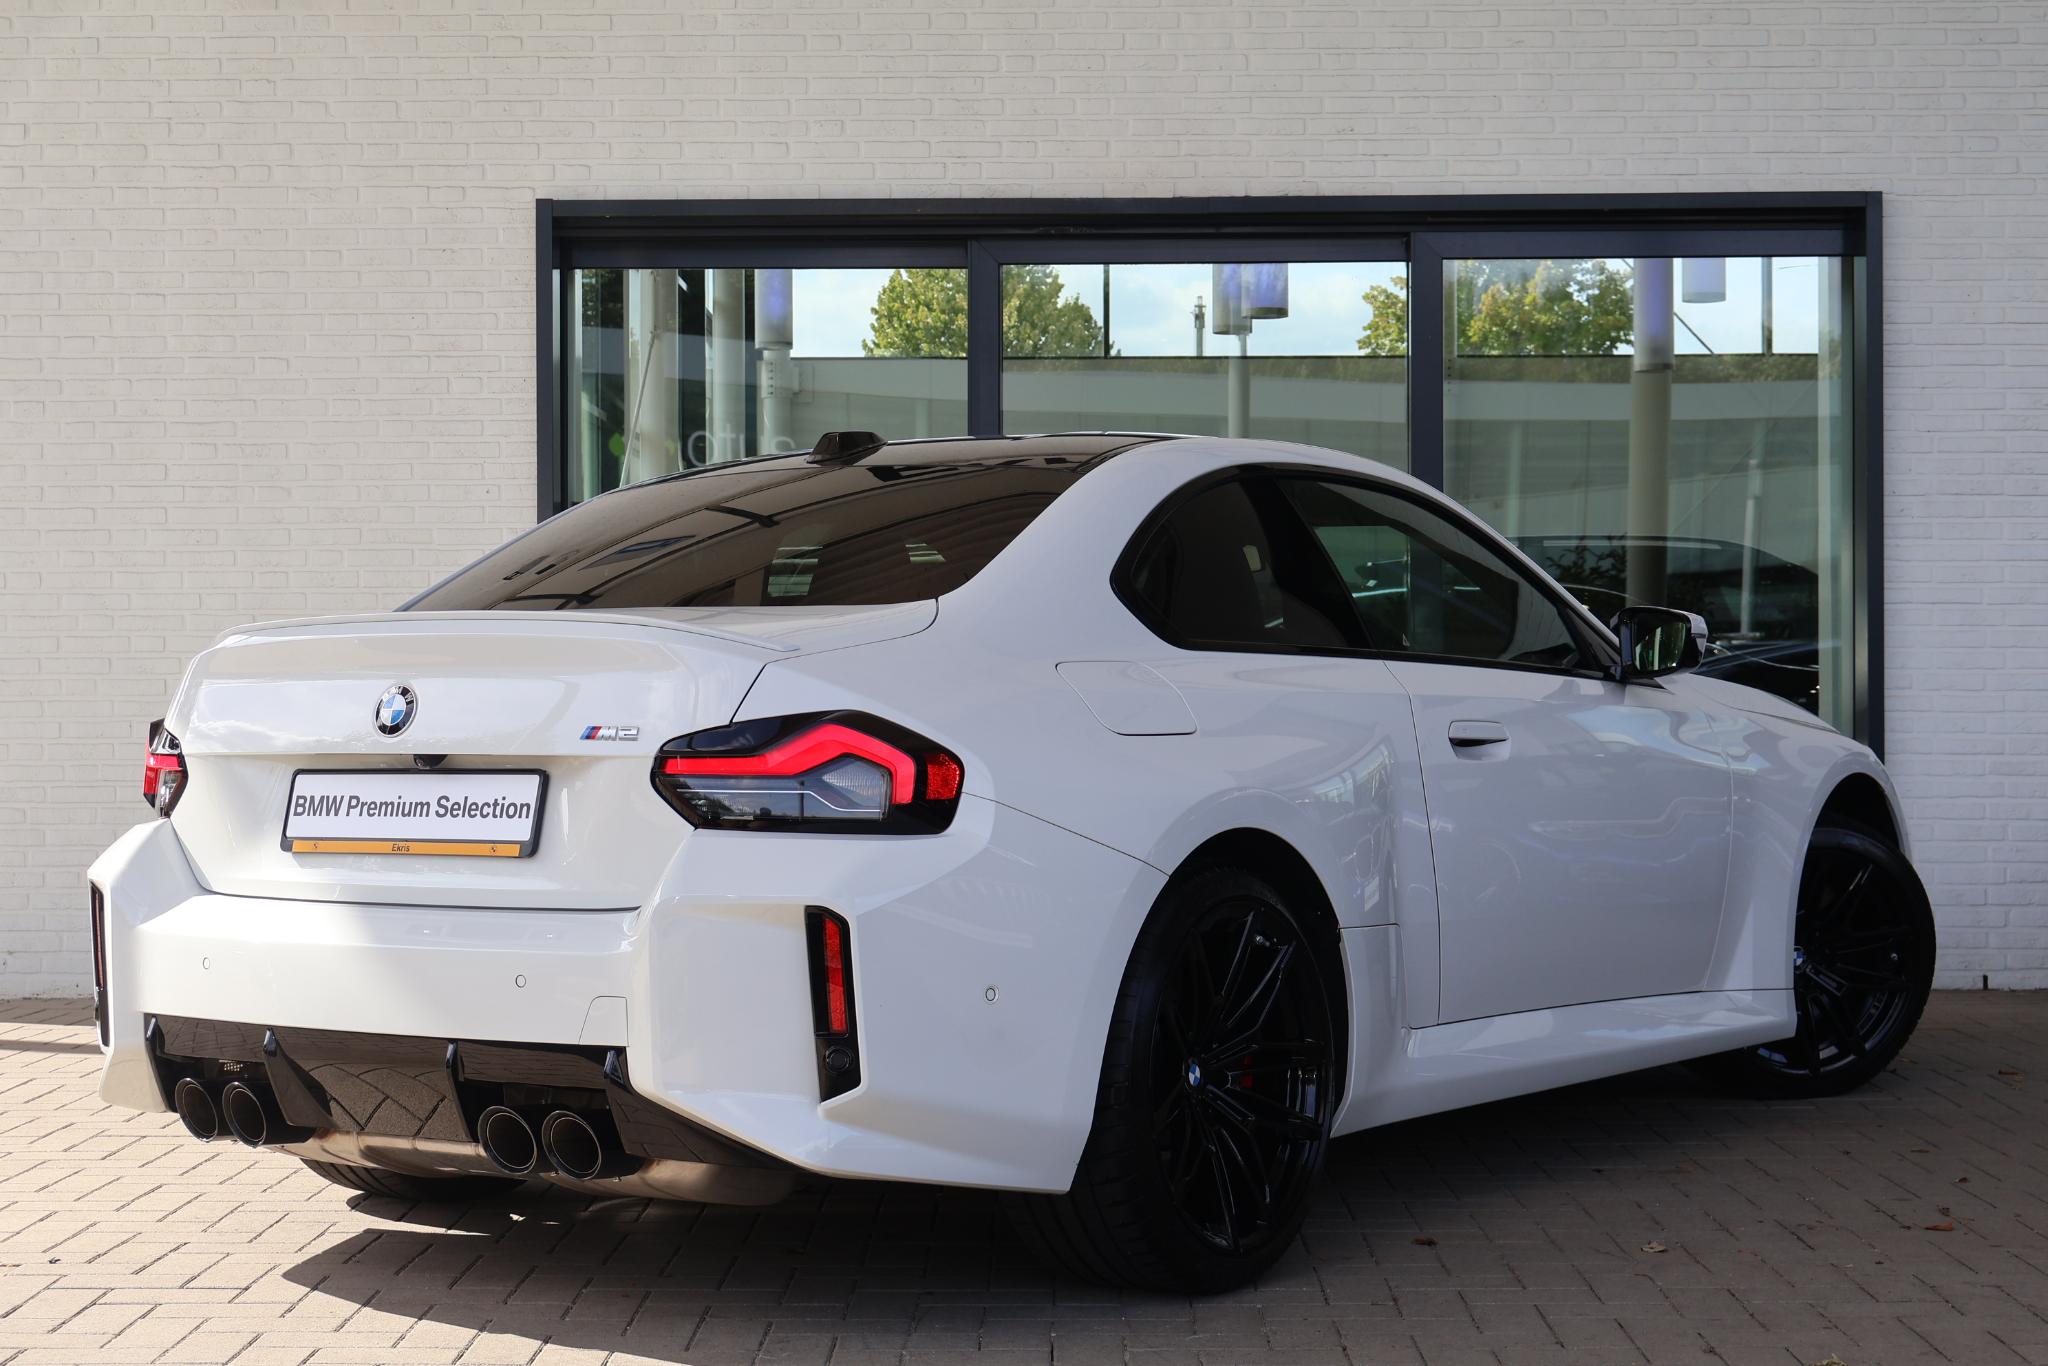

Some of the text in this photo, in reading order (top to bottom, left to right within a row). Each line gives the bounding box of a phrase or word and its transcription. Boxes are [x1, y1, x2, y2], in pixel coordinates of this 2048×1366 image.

[594, 725, 640, 741] M2
[293, 795, 531, 819] BMW Premium Selection
[391, 843, 410, 852] Ekris
